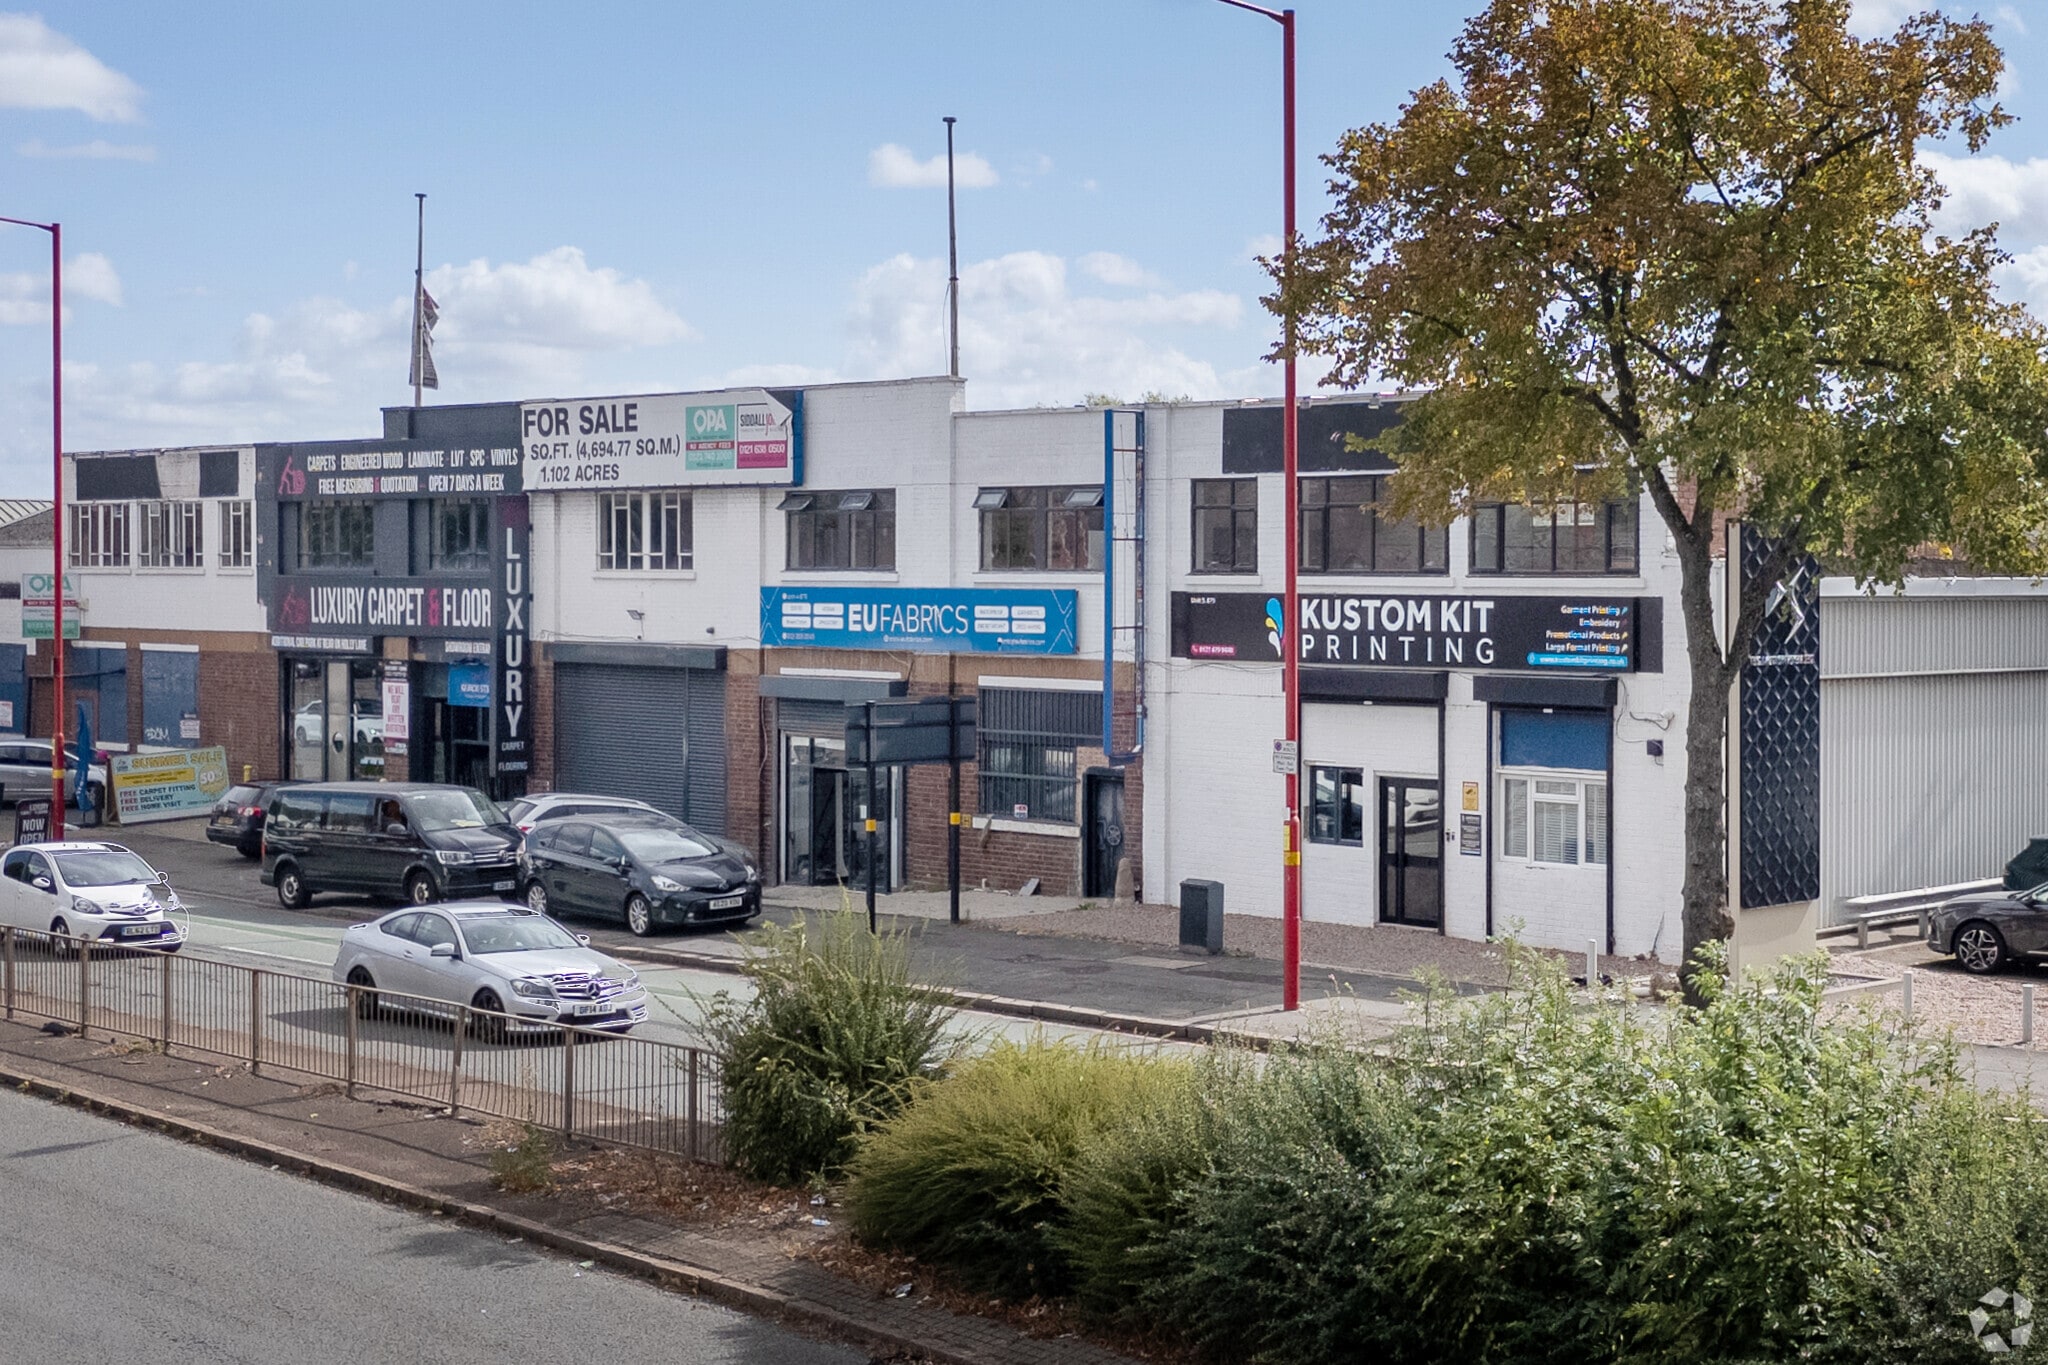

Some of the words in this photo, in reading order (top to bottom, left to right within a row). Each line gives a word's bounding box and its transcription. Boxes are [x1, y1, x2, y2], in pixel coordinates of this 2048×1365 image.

[524, 407, 570, 437] FOR
[579, 403, 638, 435] SALE
[693, 409, 727, 434] OPA
[530, 442, 572, 461] SQ.FT.
[577, 438, 631, 461] (4,694.77
[636, 434, 681, 457] SQ.M.)
[307, 454, 337, 472] CARPETS
[341, 453, 382, 471] ENGINEERED
[383, 452, 404, 469] WOOD
[407, 450, 445, 468] LAMINATE
[450, 450, 465, 467] LVT
[470, 449, 486, 466] SPC
[490, 448, 519, 466] VINYLS
[540, 466, 570, 483] 1.102
[575, 463, 620, 481] ACRES
[318, 477, 335, 495] FREE
[336, 477, 374, 494] MEASURING
[380, 476, 419, 493] QUOTATION
[428, 475, 449, 492] OPEN
[449, 475, 455, 491] 7
[455, 474, 475, 491] DAYS
[475, 474, 482, 491] A
[482, 473, 505, 491] WEEK
[310, 587, 365, 623] LUXURY
[367, 587, 424, 625] CARPET
[443, 588, 491, 627] FLOOR
[1301, 598, 1432, 633] KUSTOM
[1440, 600, 1494, 633] KIT
[1560, 605, 1591, 614] Garment
[1592, 605, 1620, 616] Printing
[505, 527, 524, 737] LUXURY
[1579, 618, 1620, 629] Embroidery
[1545, 630, 1588, 639] Promotional
[1589, 631, 1620, 640] Products
[1302, 634, 1495, 664] PRINTING
[1545, 642, 1565, 653] Large
[1566, 643, 1591, 652] Format
[1591, 643, 1620, 655] Printing
[501, 741, 524, 751] CARPET
[132, 754, 187, 769] SUMMER
[190, 751, 223, 765] SALE
[139, 786, 167, 795] CARPET
[168, 784, 196, 792] FITTING
[22, 818, 46, 832] NOW
[20, 833, 46, 845] OPEN
